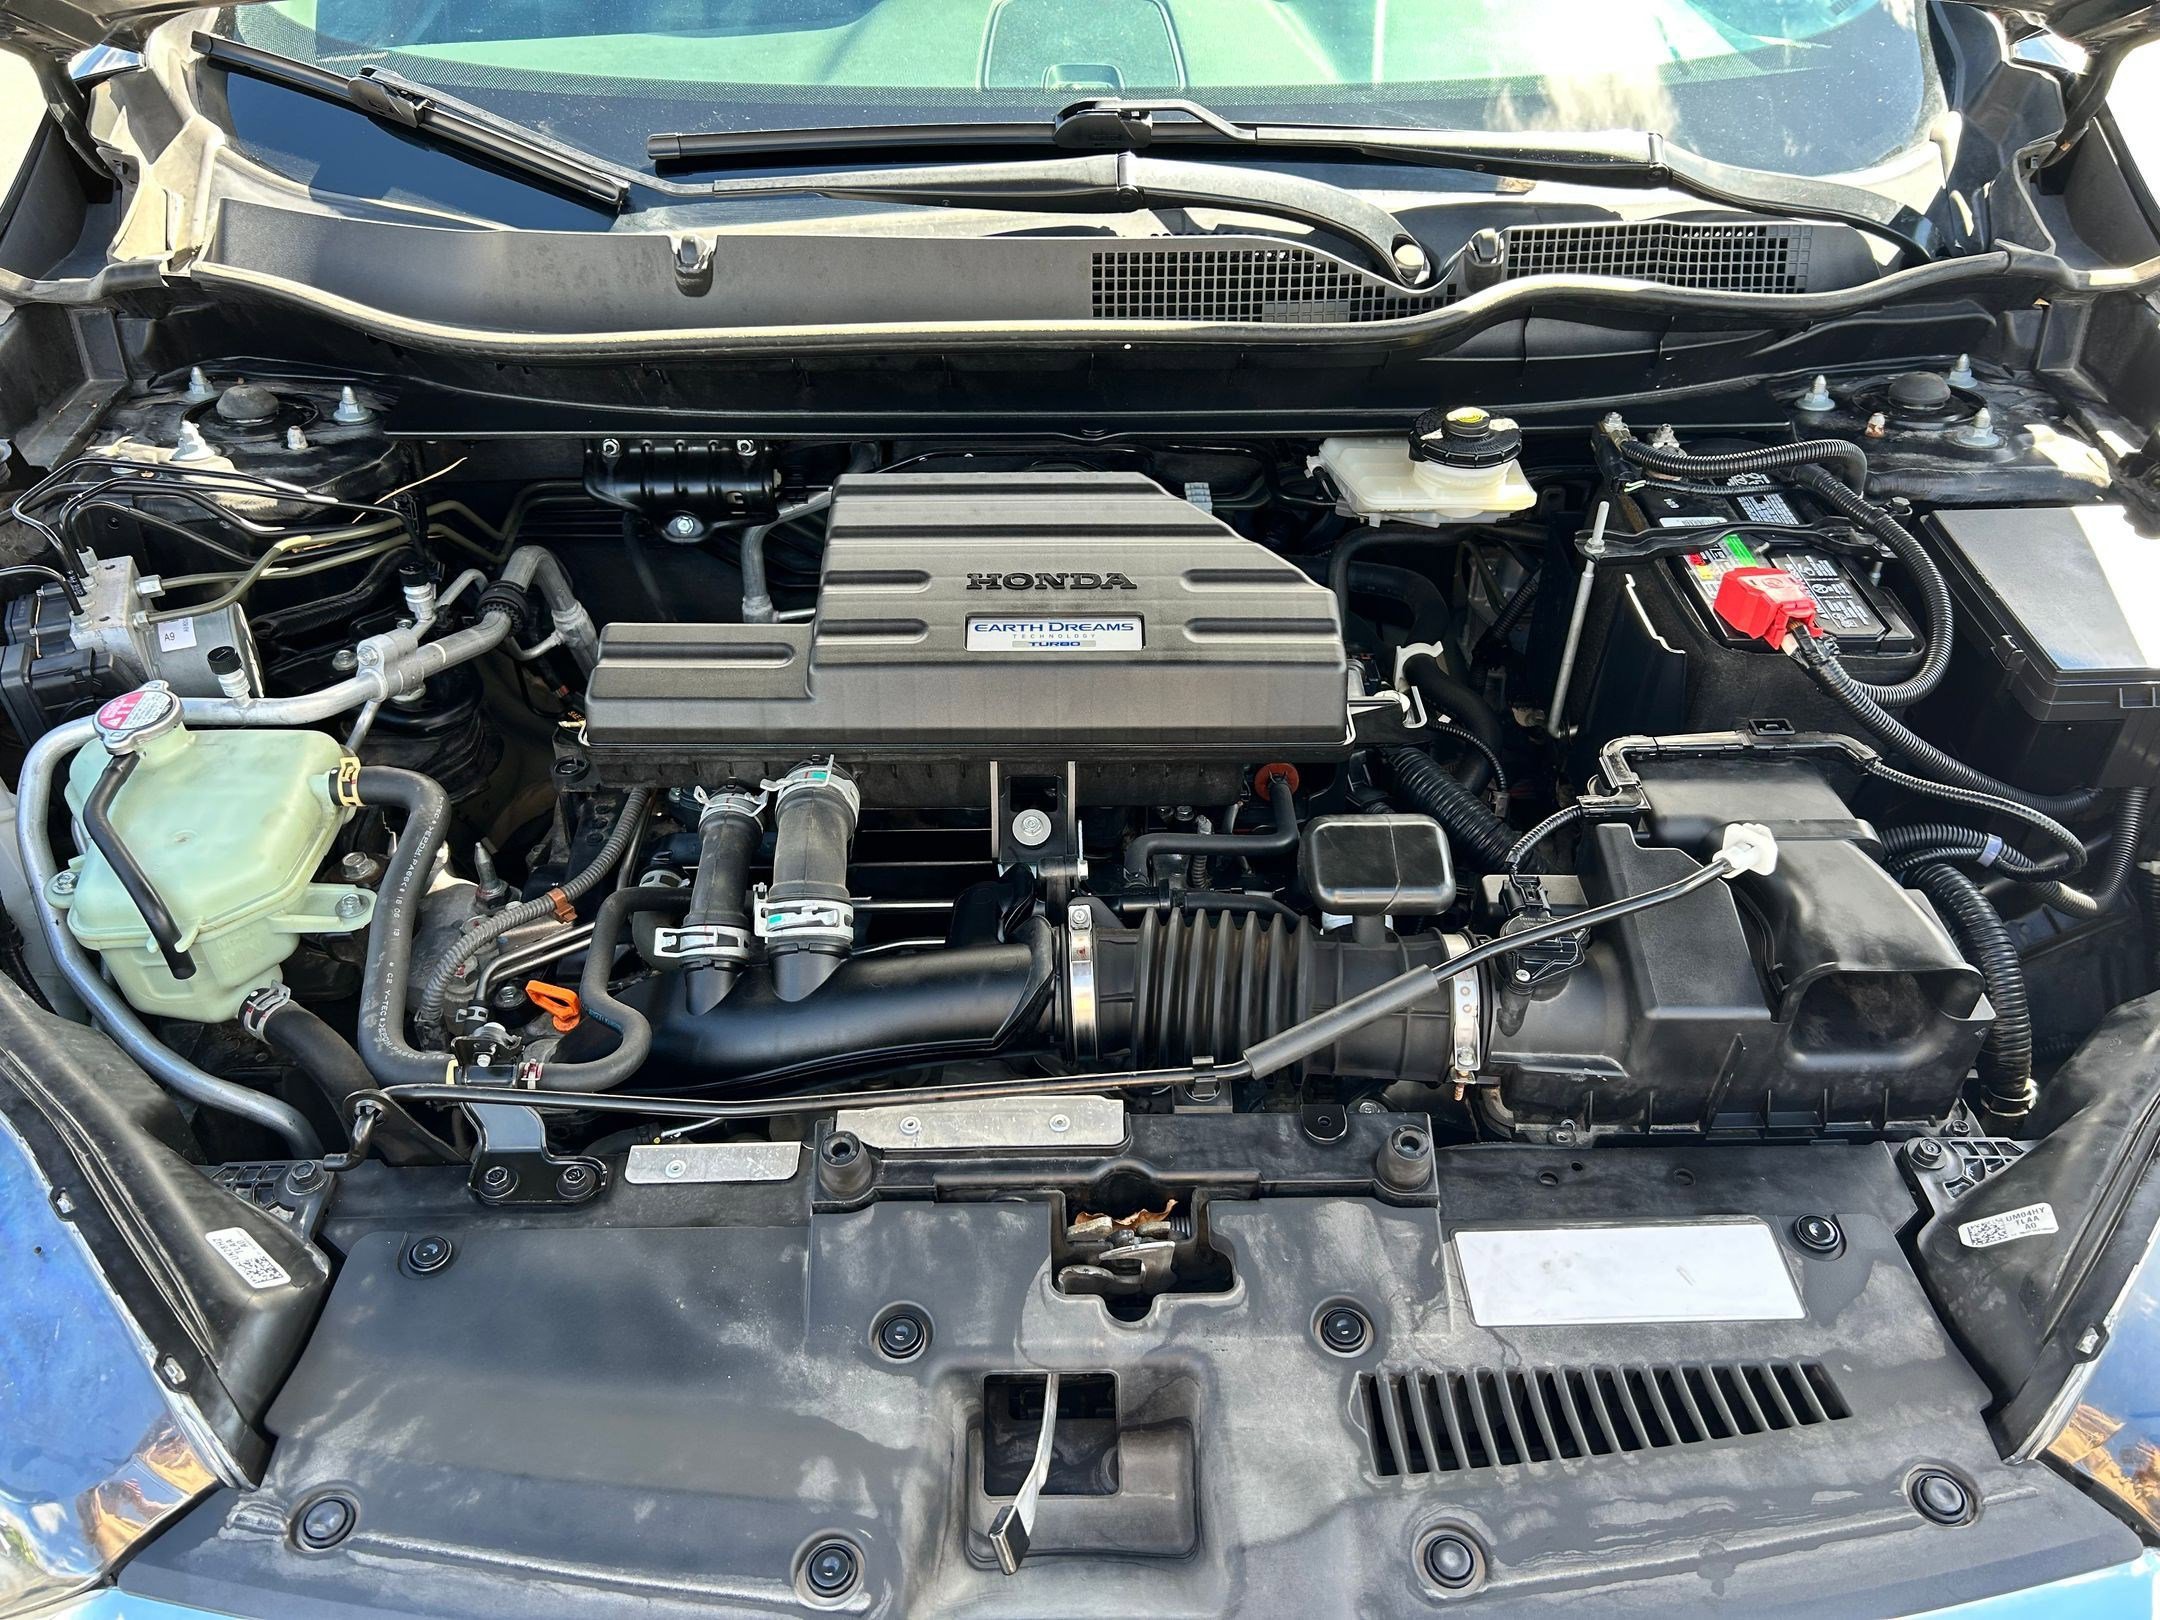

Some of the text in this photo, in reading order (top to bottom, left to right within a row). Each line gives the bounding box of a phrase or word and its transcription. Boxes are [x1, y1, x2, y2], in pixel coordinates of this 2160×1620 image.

[966, 572, 1138, 590] HONDA
[974, 621, 1134, 632] EARTH DREAMS
[165, 631, 176, 642] A9
[379, 989, 391, 1017] Y-TEC
[2005, 1206, 2045, 1222] UM04HY
[2015, 1215, 2040, 1226] TLAA
